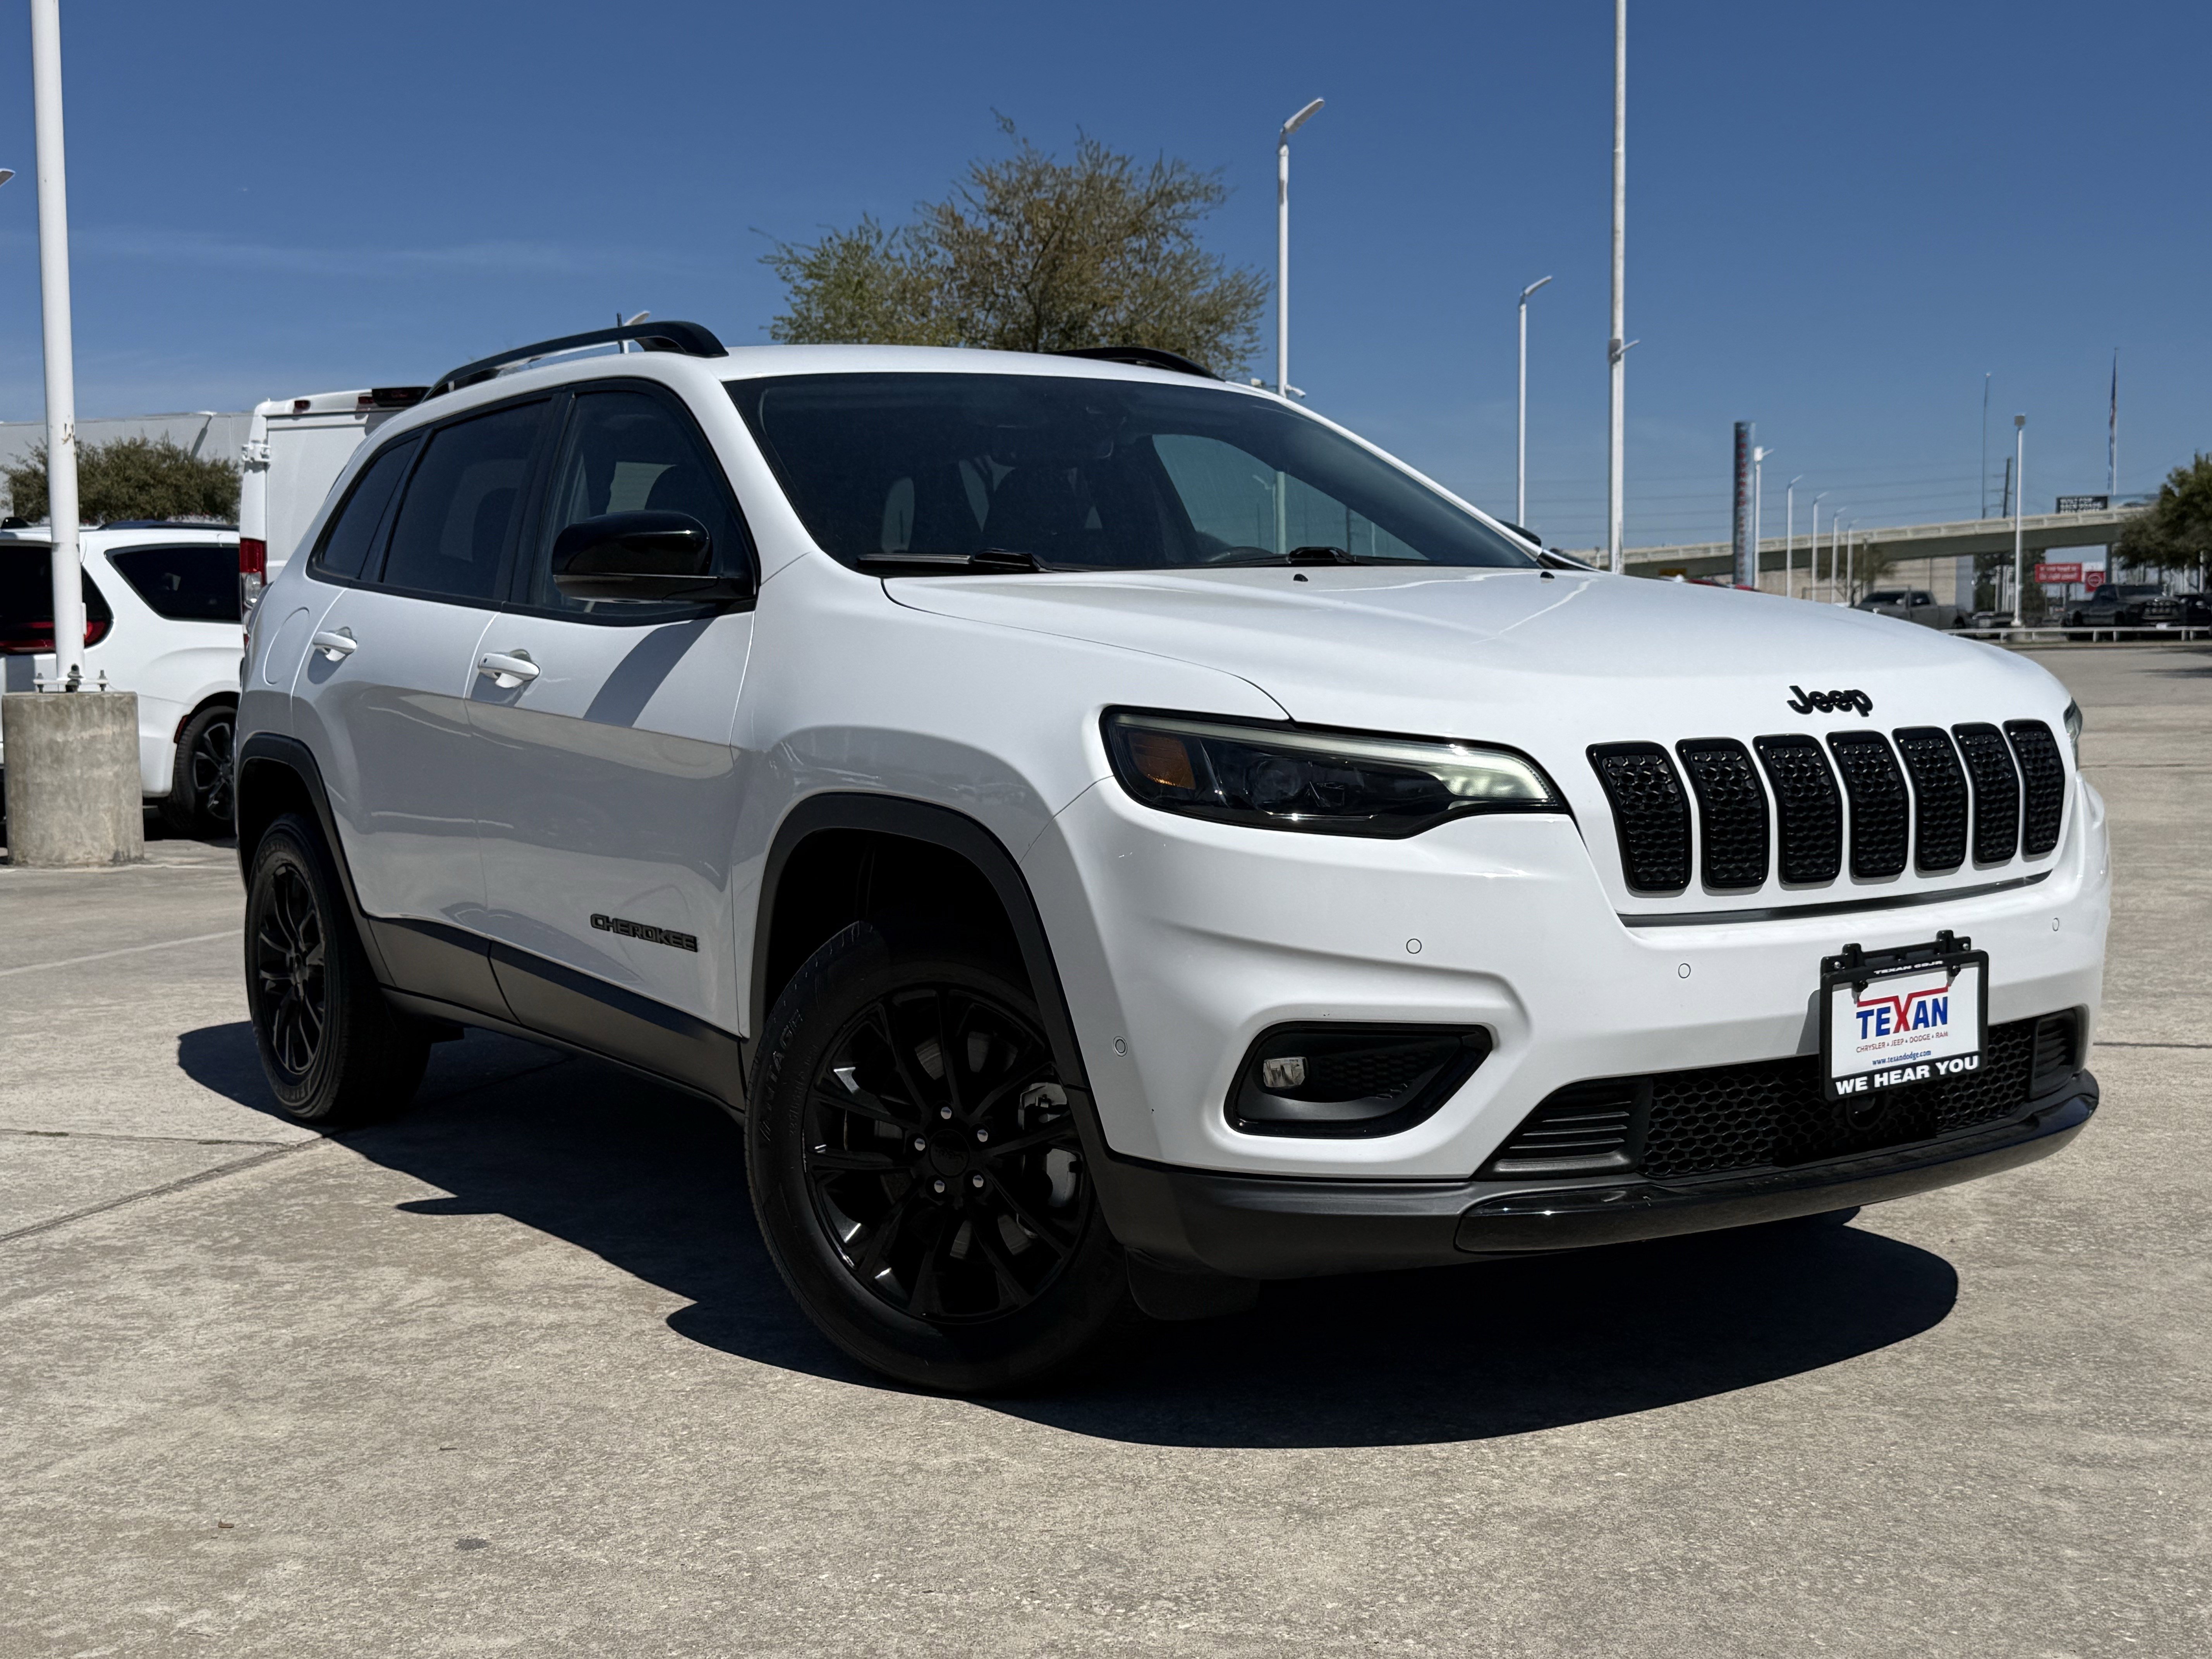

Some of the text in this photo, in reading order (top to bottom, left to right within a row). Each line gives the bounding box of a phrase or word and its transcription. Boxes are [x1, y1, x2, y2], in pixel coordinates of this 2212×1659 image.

[1786, 685, 1873, 717] Jeep
[590, 913, 698, 953] CHEROKEE
[1856, 986, 1949, 1040] TEXAN
[1856, 1042, 1885, 1053] CHRYSLER
[1891, 1038, 1904, 1047] JEEP
[1910, 1034, 1930, 1043] DODGE
[1872, 1049, 1931, 1066] www.texandodge.com
[1836, 1055, 1979, 1095] WE HEAR YOU
